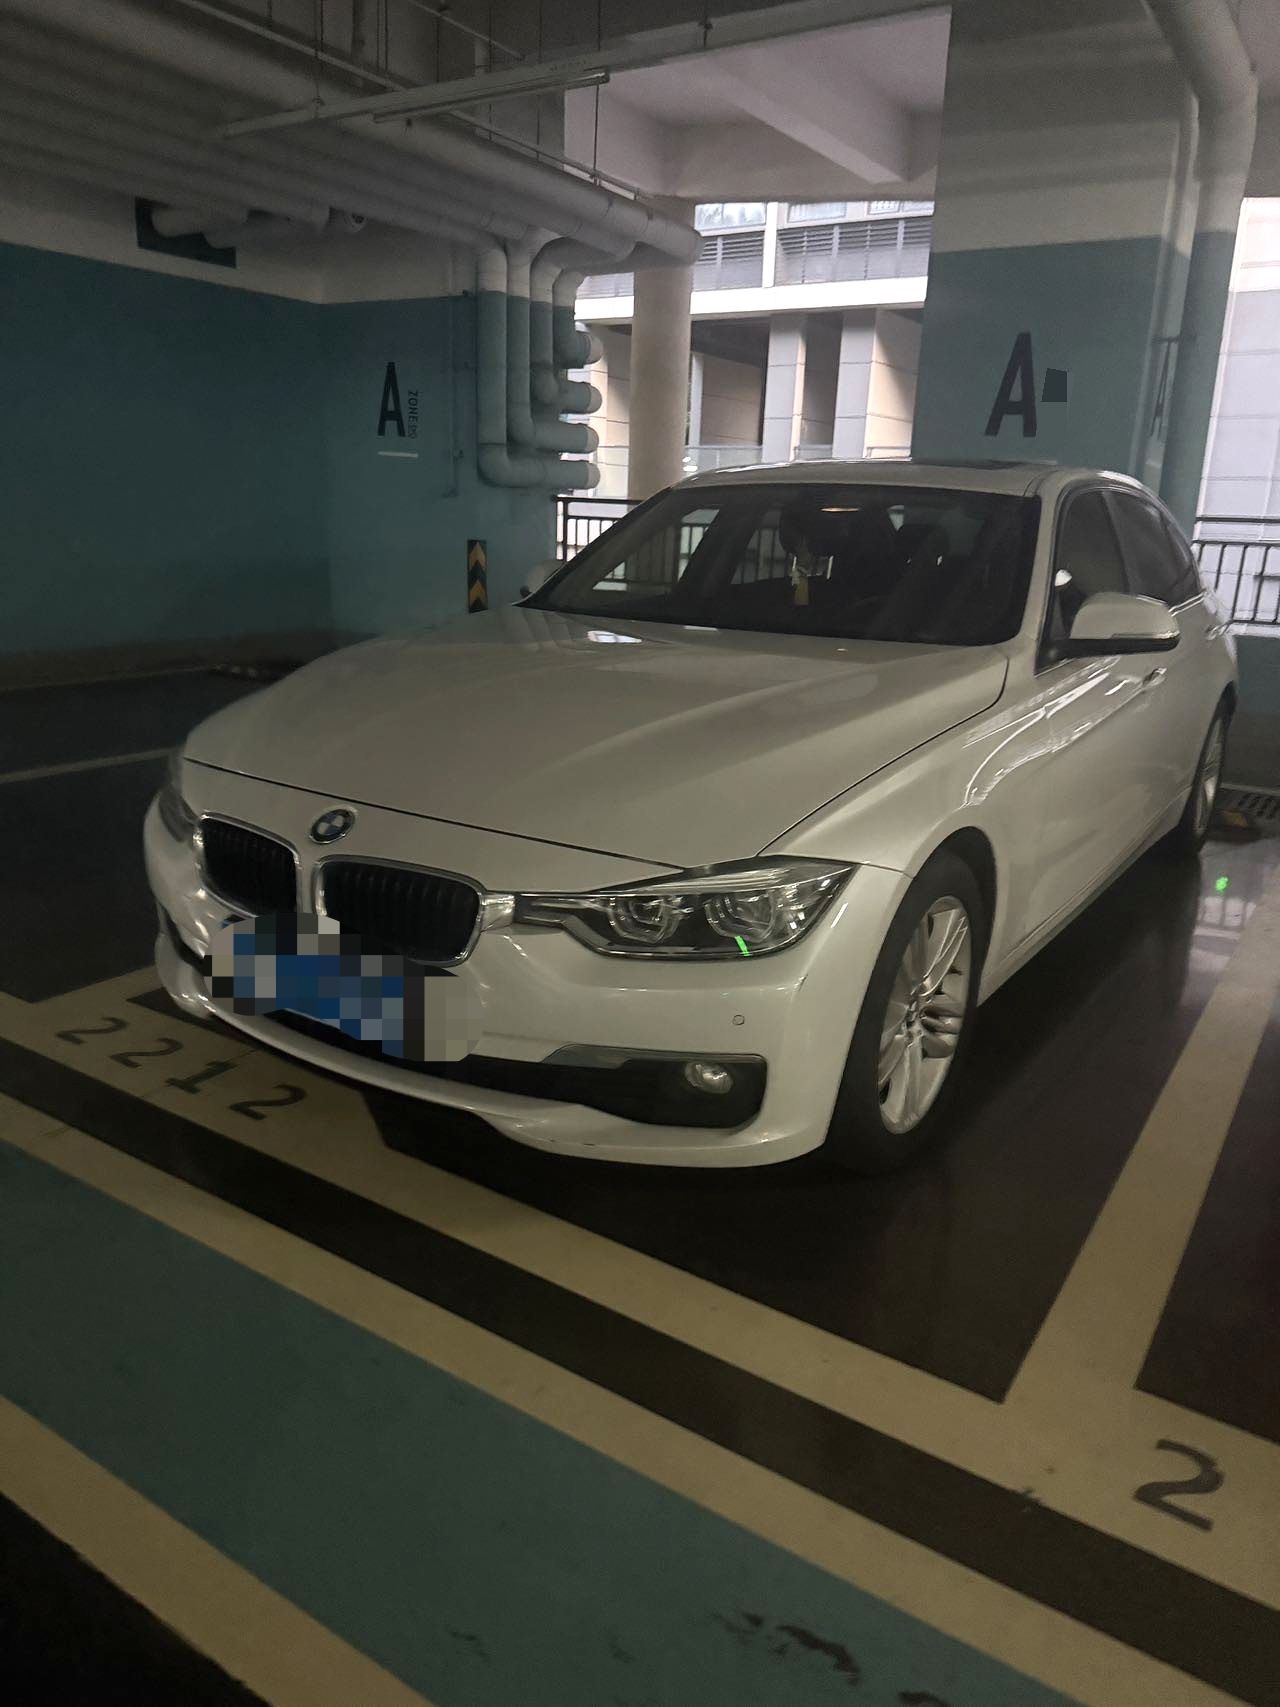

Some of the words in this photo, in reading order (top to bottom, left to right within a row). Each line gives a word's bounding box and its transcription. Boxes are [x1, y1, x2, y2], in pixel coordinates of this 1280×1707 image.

[378, 362, 406, 437] A
[985, 332, 1037, 437] A
[55, 1017, 308, 1121] 2212
[1134, 1438, 1225, 1532] 2
